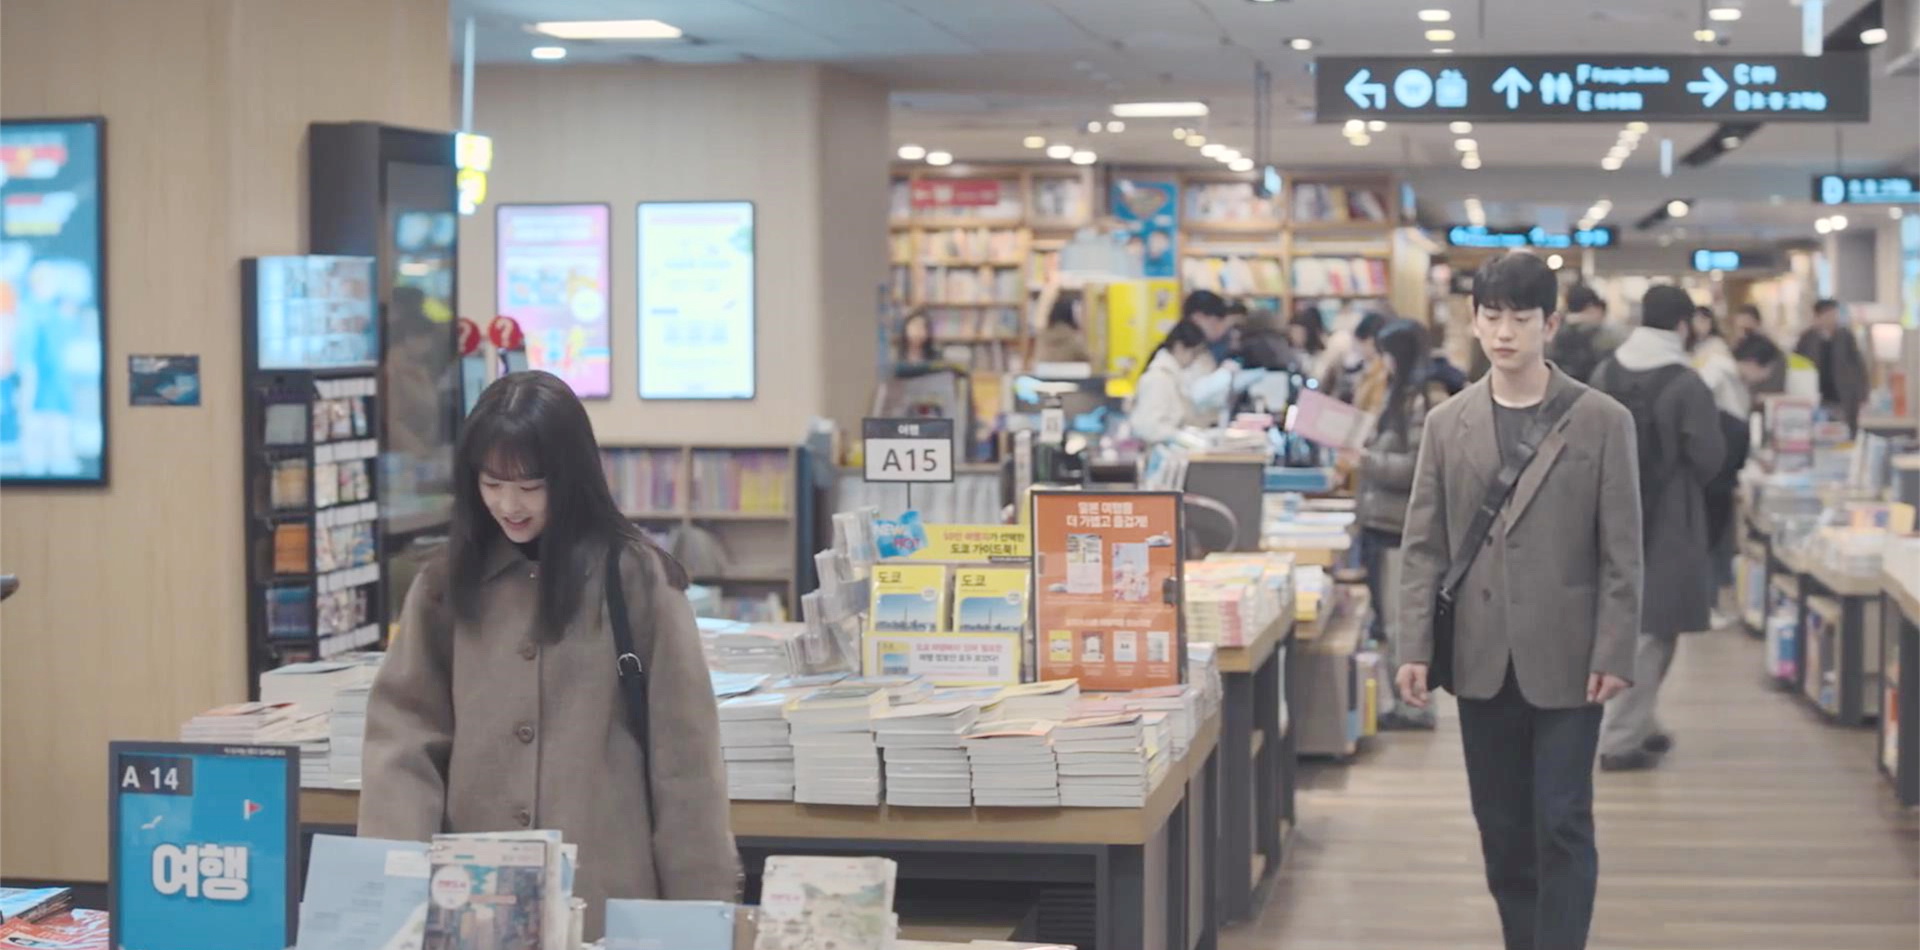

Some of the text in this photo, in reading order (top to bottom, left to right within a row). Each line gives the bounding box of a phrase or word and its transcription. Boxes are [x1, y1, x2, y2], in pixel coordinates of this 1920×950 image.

[882, 448, 937, 472] A15
[1066, 515, 1078, 528] 더
[879, 571, 902, 583] 도쿄
[961, 575, 986, 587] 도쿄
[121, 765, 179, 791] A 14
[152, 843, 249, 901] 여행
